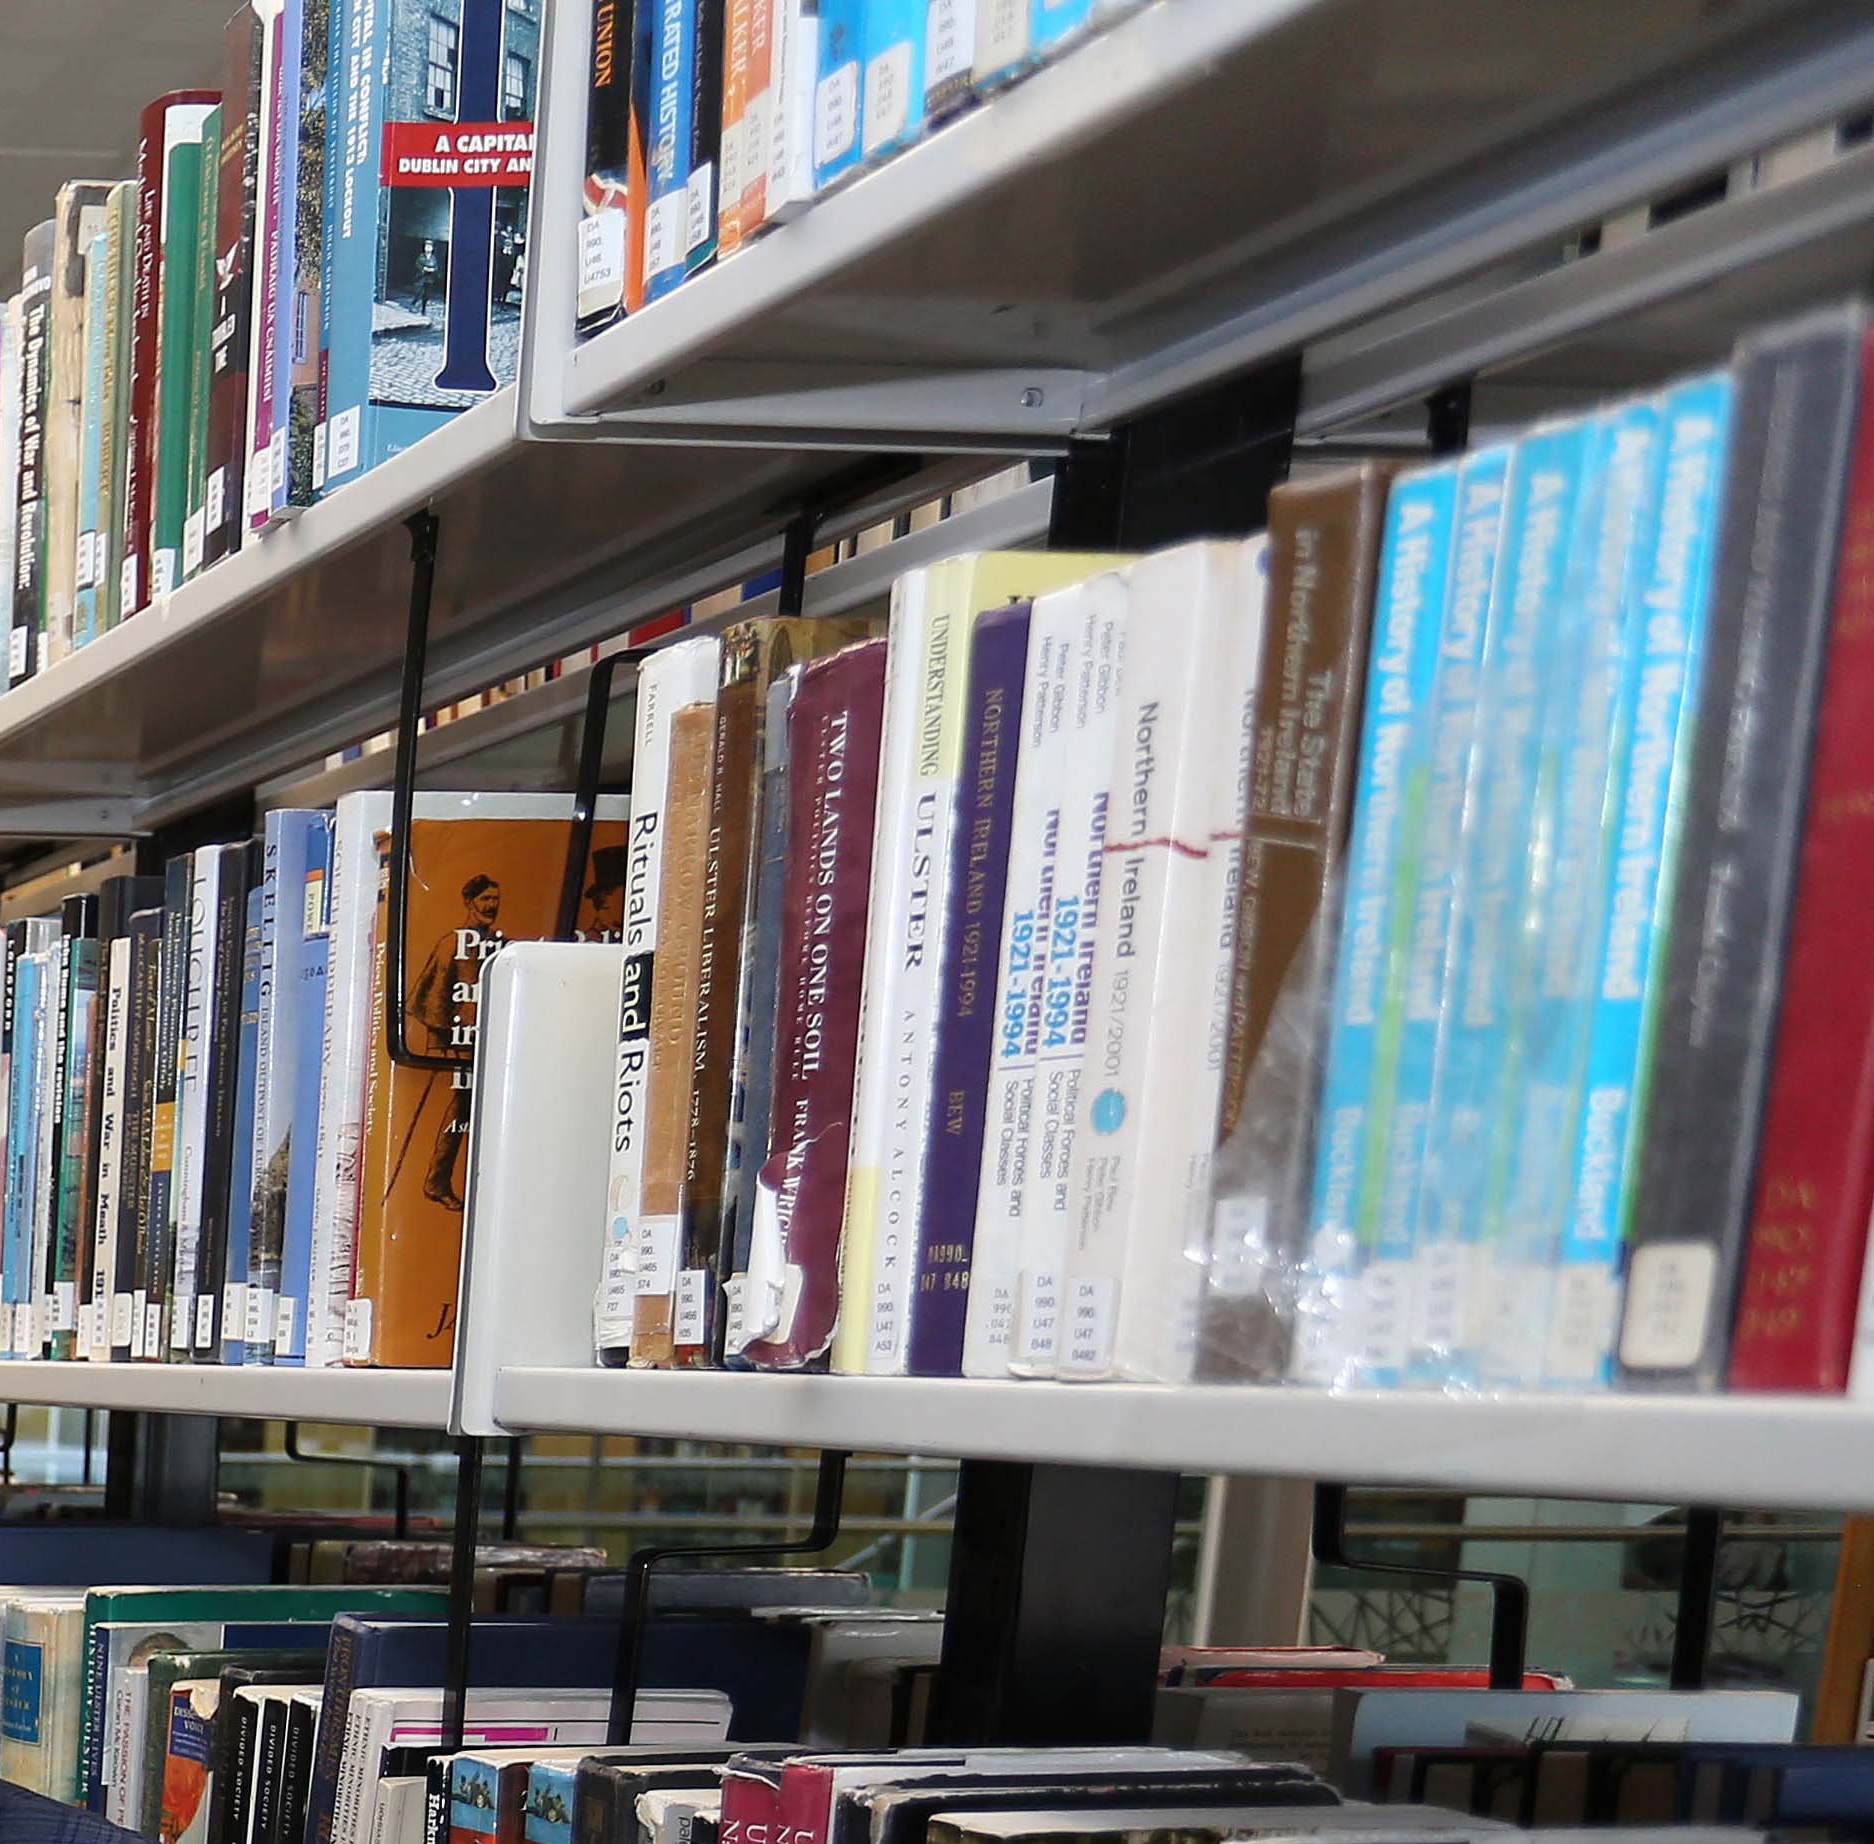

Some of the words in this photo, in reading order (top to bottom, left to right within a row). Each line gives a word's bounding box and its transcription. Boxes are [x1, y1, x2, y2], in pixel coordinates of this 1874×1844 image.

[398, 157, 455, 174] DUBLIN
[458, 158, 498, 173] CITY
[501, 157, 532, 174] AN
[23, 304, 44, 335] The
[19, 338, 43, 412] Dynamics
[22, 416, 41, 431] of
[21, 434, 41, 466] War
[21, 470, 39, 499] and
[17, 502, 38, 589] Revolution:
[919, 614, 950, 778] UNDERSTANDING
[825, 710, 849, 785] TWO
[975, 688, 1004, 809] NORTHERN
[1130, 699, 1161, 839] Northern
[624, 810, 660, 948] Rituals
[816, 789, 844, 888] LANDS
[902, 792, 937, 974] ULSTER
[965, 816, 992, 915] IRELAND
[258, 843, 279, 1000] SKELLIG
[812, 893, 837, 938] ON
[1114, 854, 1146, 960] Ireland
[618, 958, 649, 1034] and
[808, 943, 832, 1009] ONE
[957, 922, 983, 1018] 1921-1994
[1000, 908, 1036, 1062] 1921-1994
[1041, 895, 1077, 1051] 1921-1994
[800, 1012, 827, 1082] SOIL
[894, 1008, 916, 1133] ANTONY
[1102, 967, 1133, 1080] 1921/2001
[612, 1049, 645, 1153] Riots
[944, 1089, 966, 1136] BEW
[882, 1148, 909, 1271] ALCOCK
